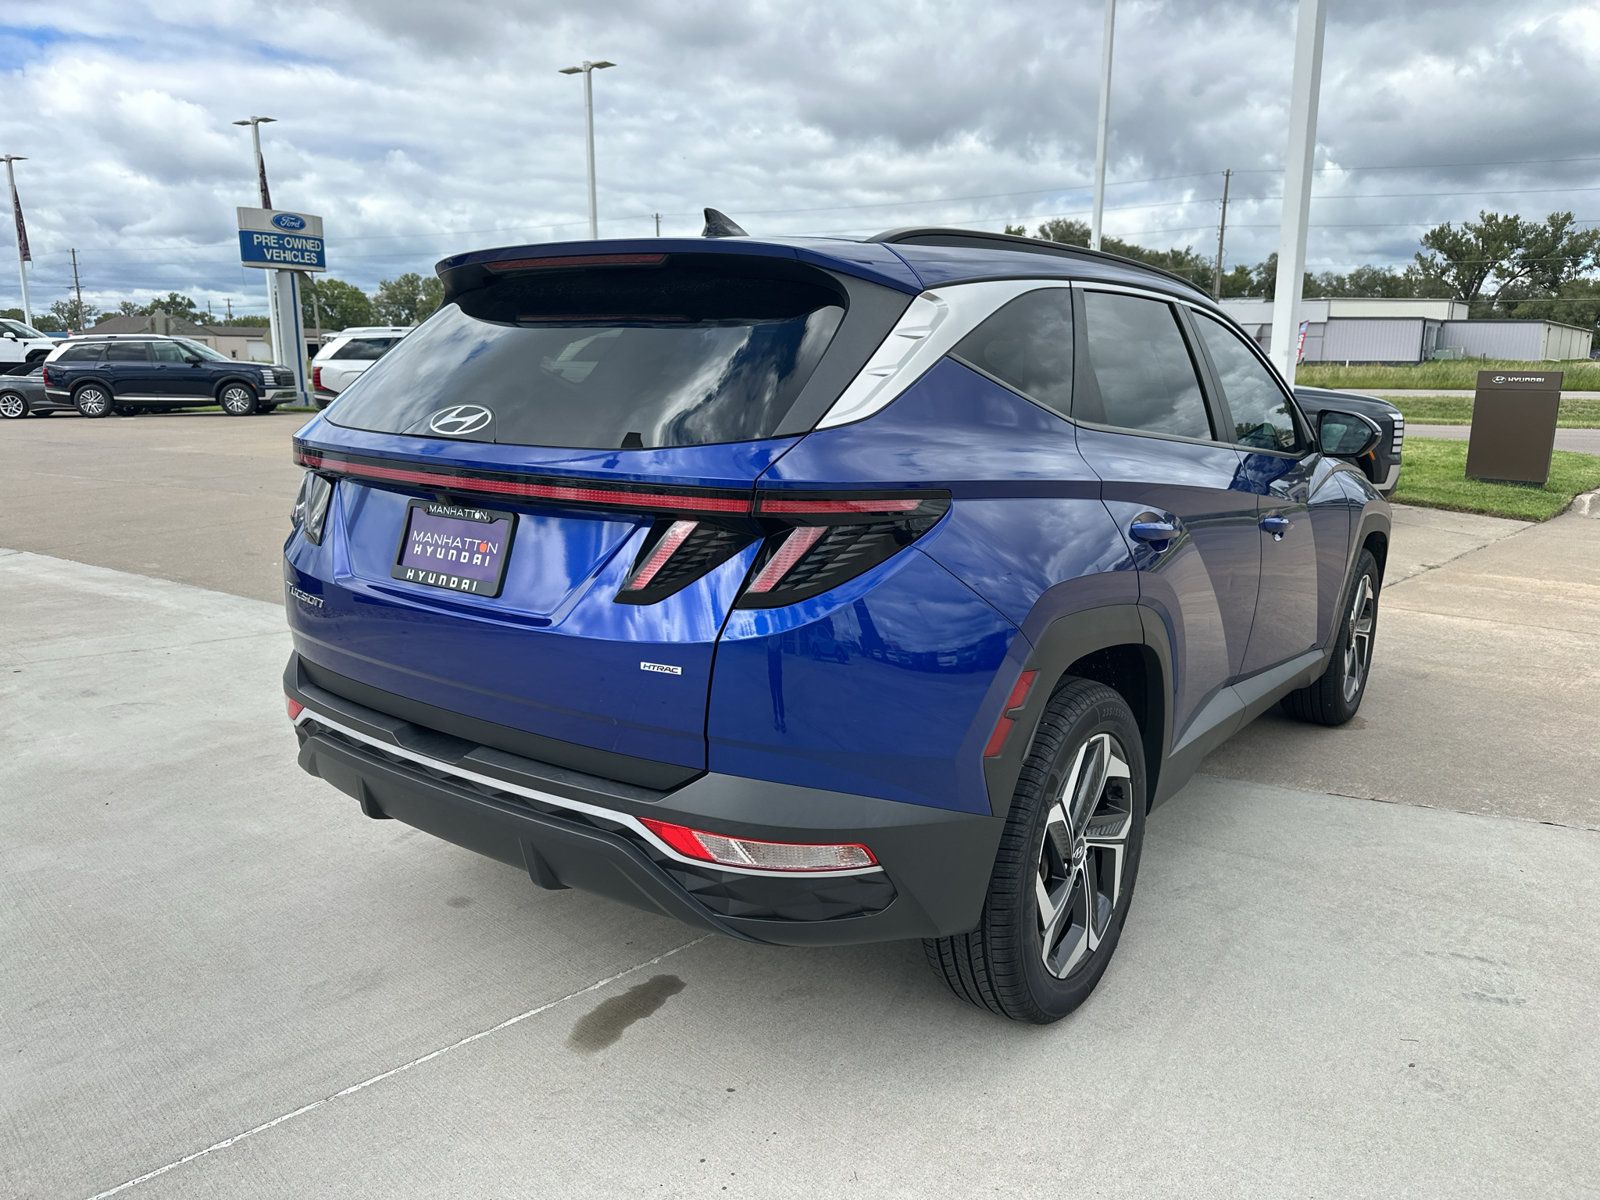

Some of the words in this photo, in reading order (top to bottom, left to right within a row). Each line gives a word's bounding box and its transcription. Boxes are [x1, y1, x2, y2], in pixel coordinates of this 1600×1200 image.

[280, 216, 301, 228] Ford
[264, 249, 317, 264] VEHICLES
[414, 543, 490, 567] HYUNDAI
[406, 568, 477, 592] HYUNDAI
[643, 663, 679, 674] HTRAC
